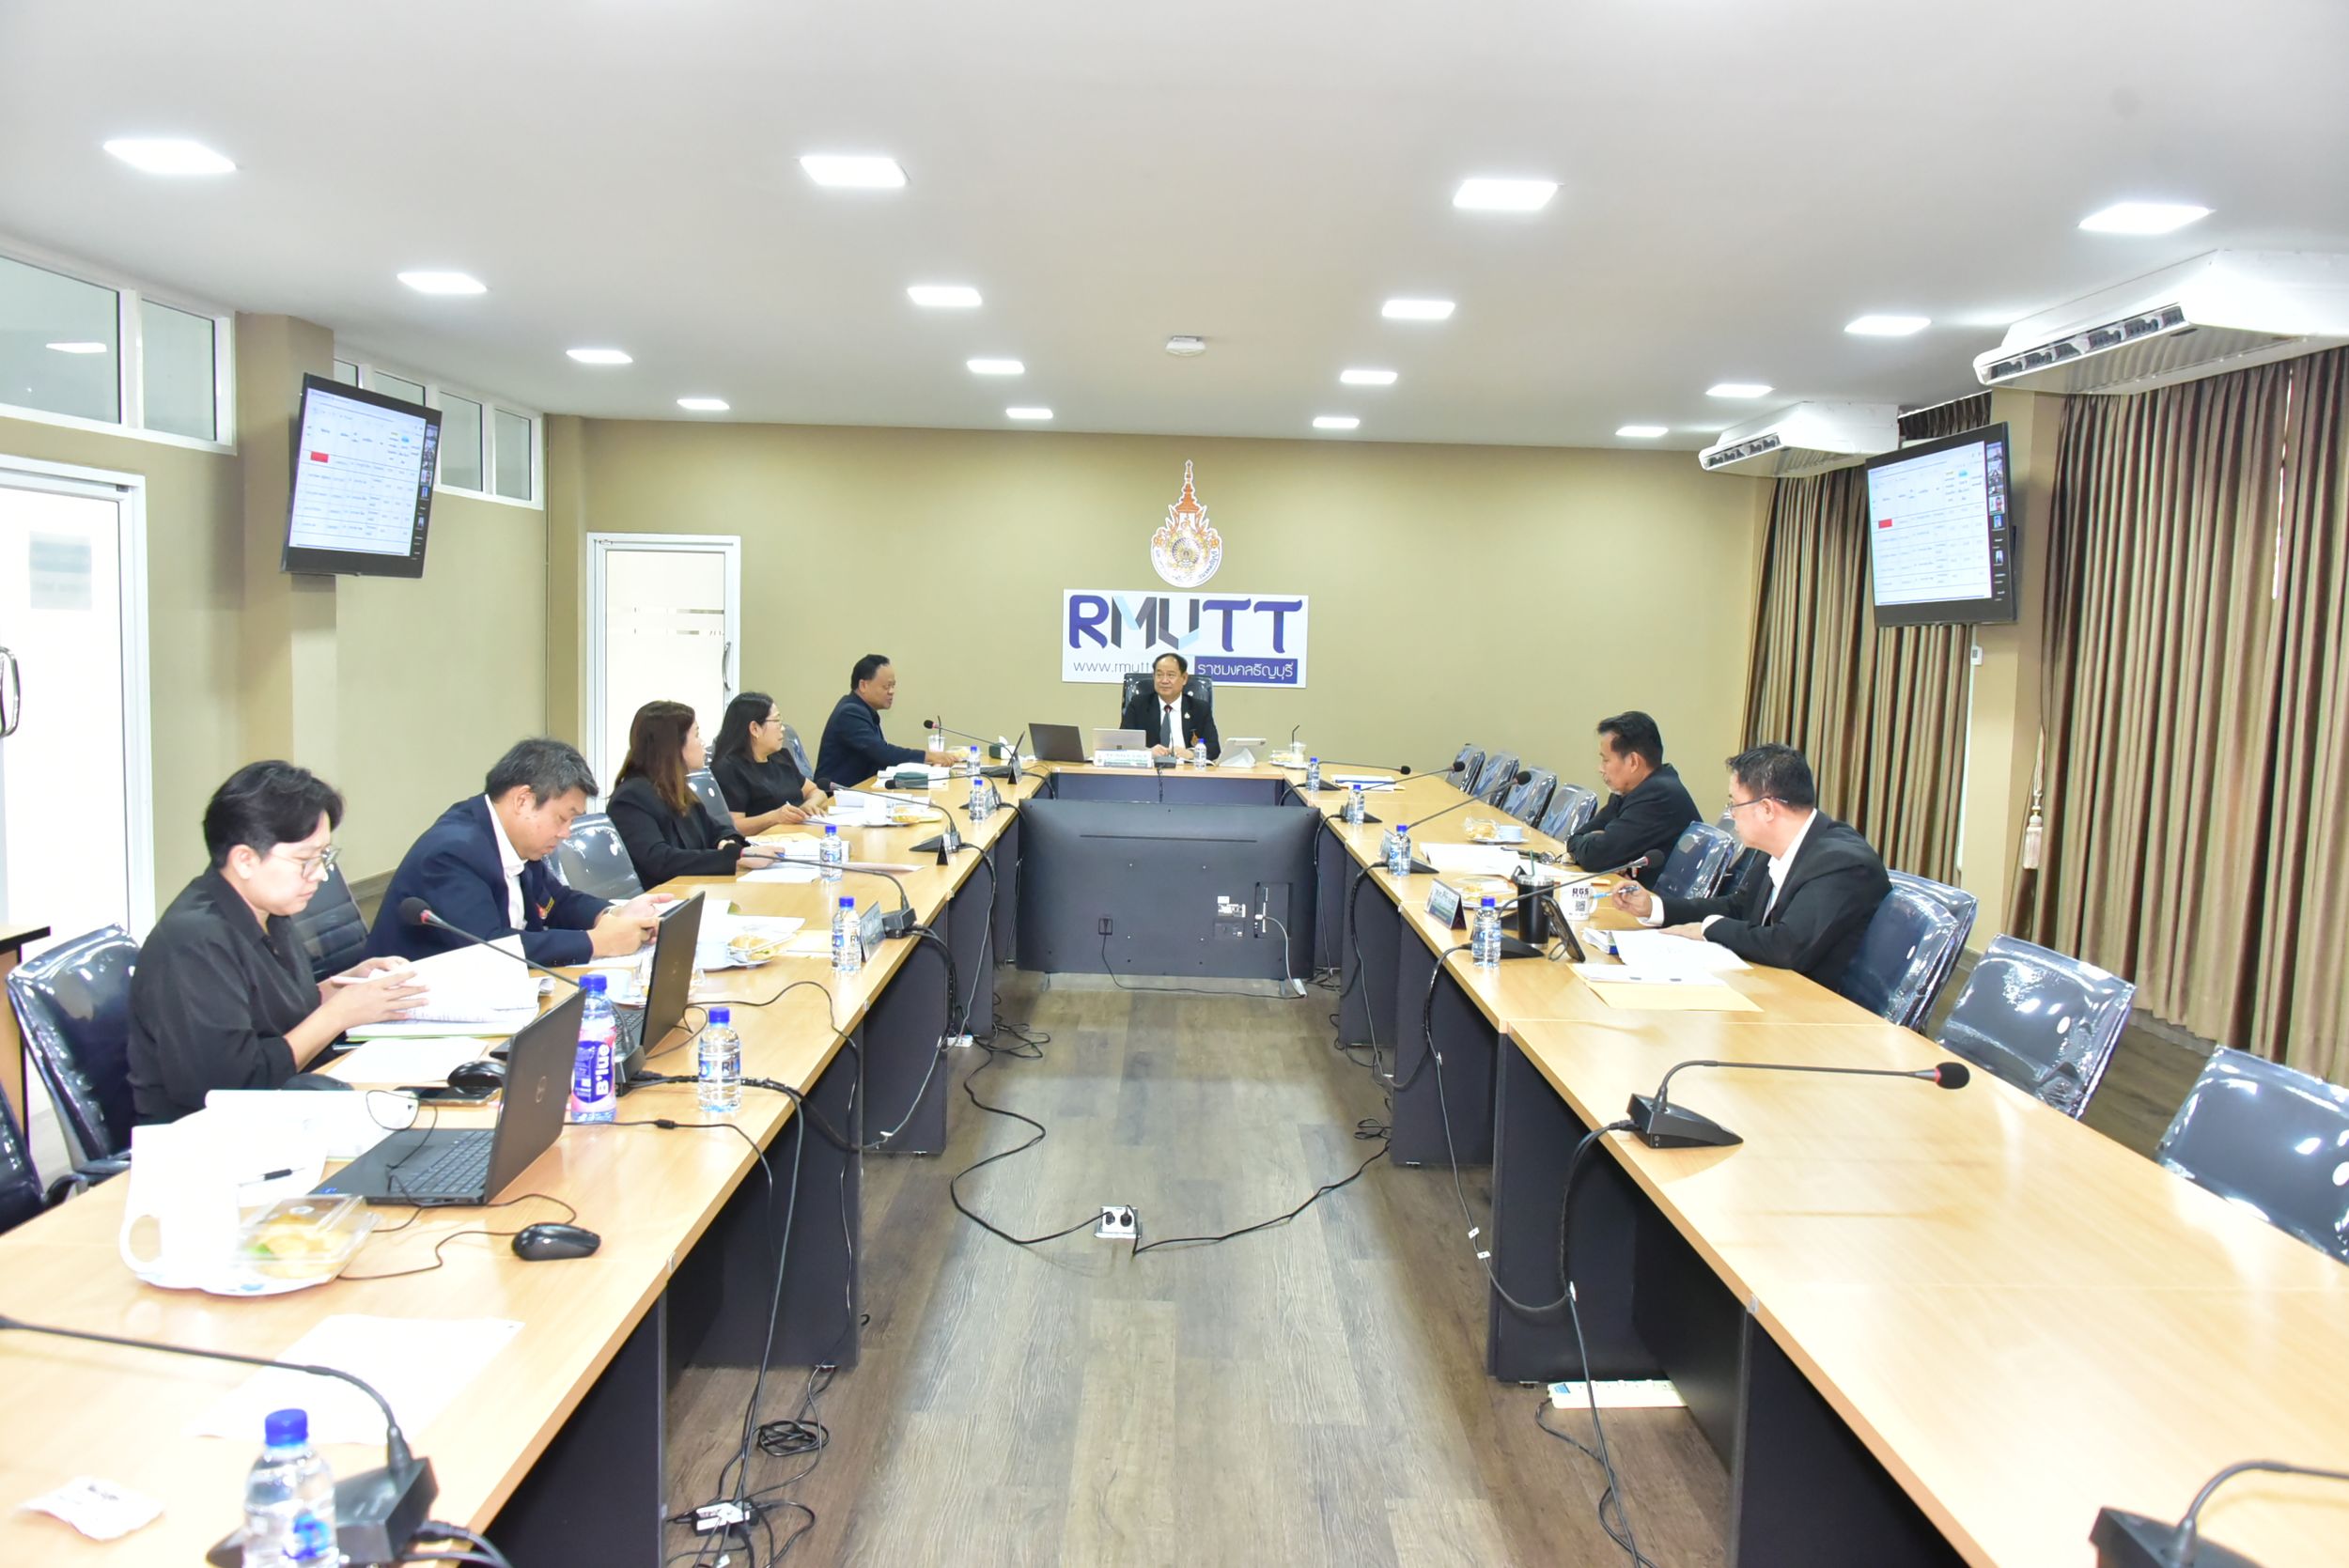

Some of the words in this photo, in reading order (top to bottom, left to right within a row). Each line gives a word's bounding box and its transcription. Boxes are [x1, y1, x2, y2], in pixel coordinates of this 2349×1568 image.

[1069, 595, 1303, 654] RMUTT
[1073, 661, 1150, 673] www.rmutt
[1197, 662, 1294, 681] ราชมงคลธัญบุรี
